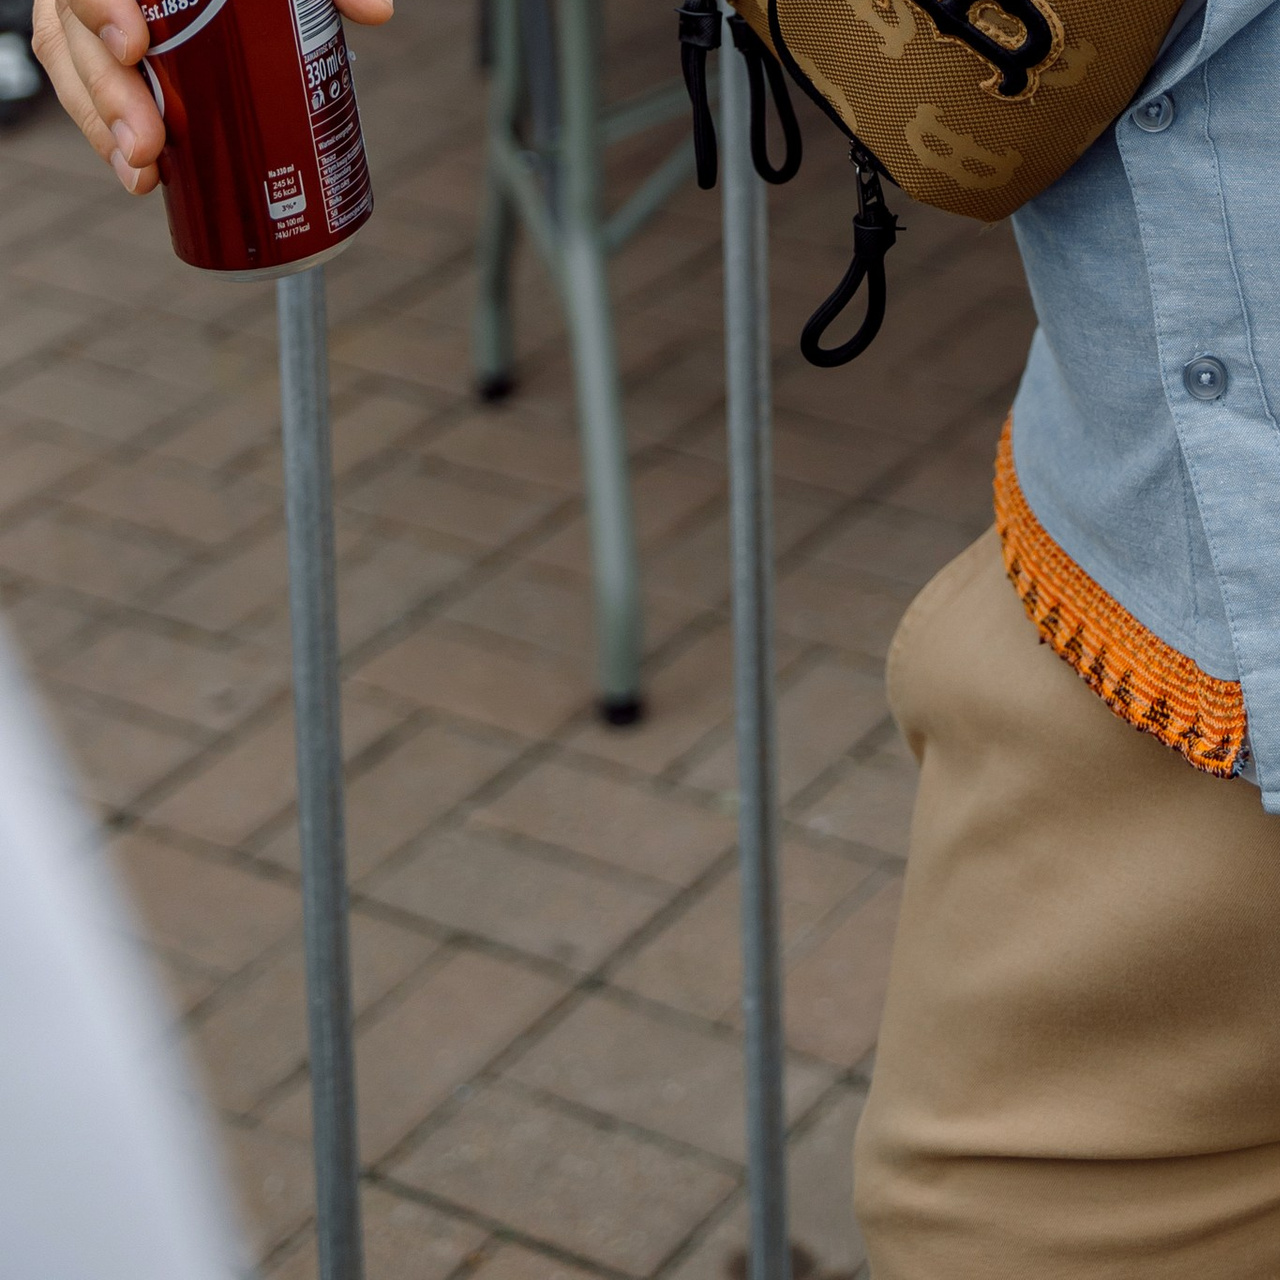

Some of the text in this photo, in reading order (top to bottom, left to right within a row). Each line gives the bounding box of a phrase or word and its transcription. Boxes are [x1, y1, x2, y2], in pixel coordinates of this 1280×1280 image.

[305, 57, 327, 89] 330
[326, 47, 339, 78] ml
[272, 178, 287, 190] 245
[272, 185, 297, 200] 56 kcal
